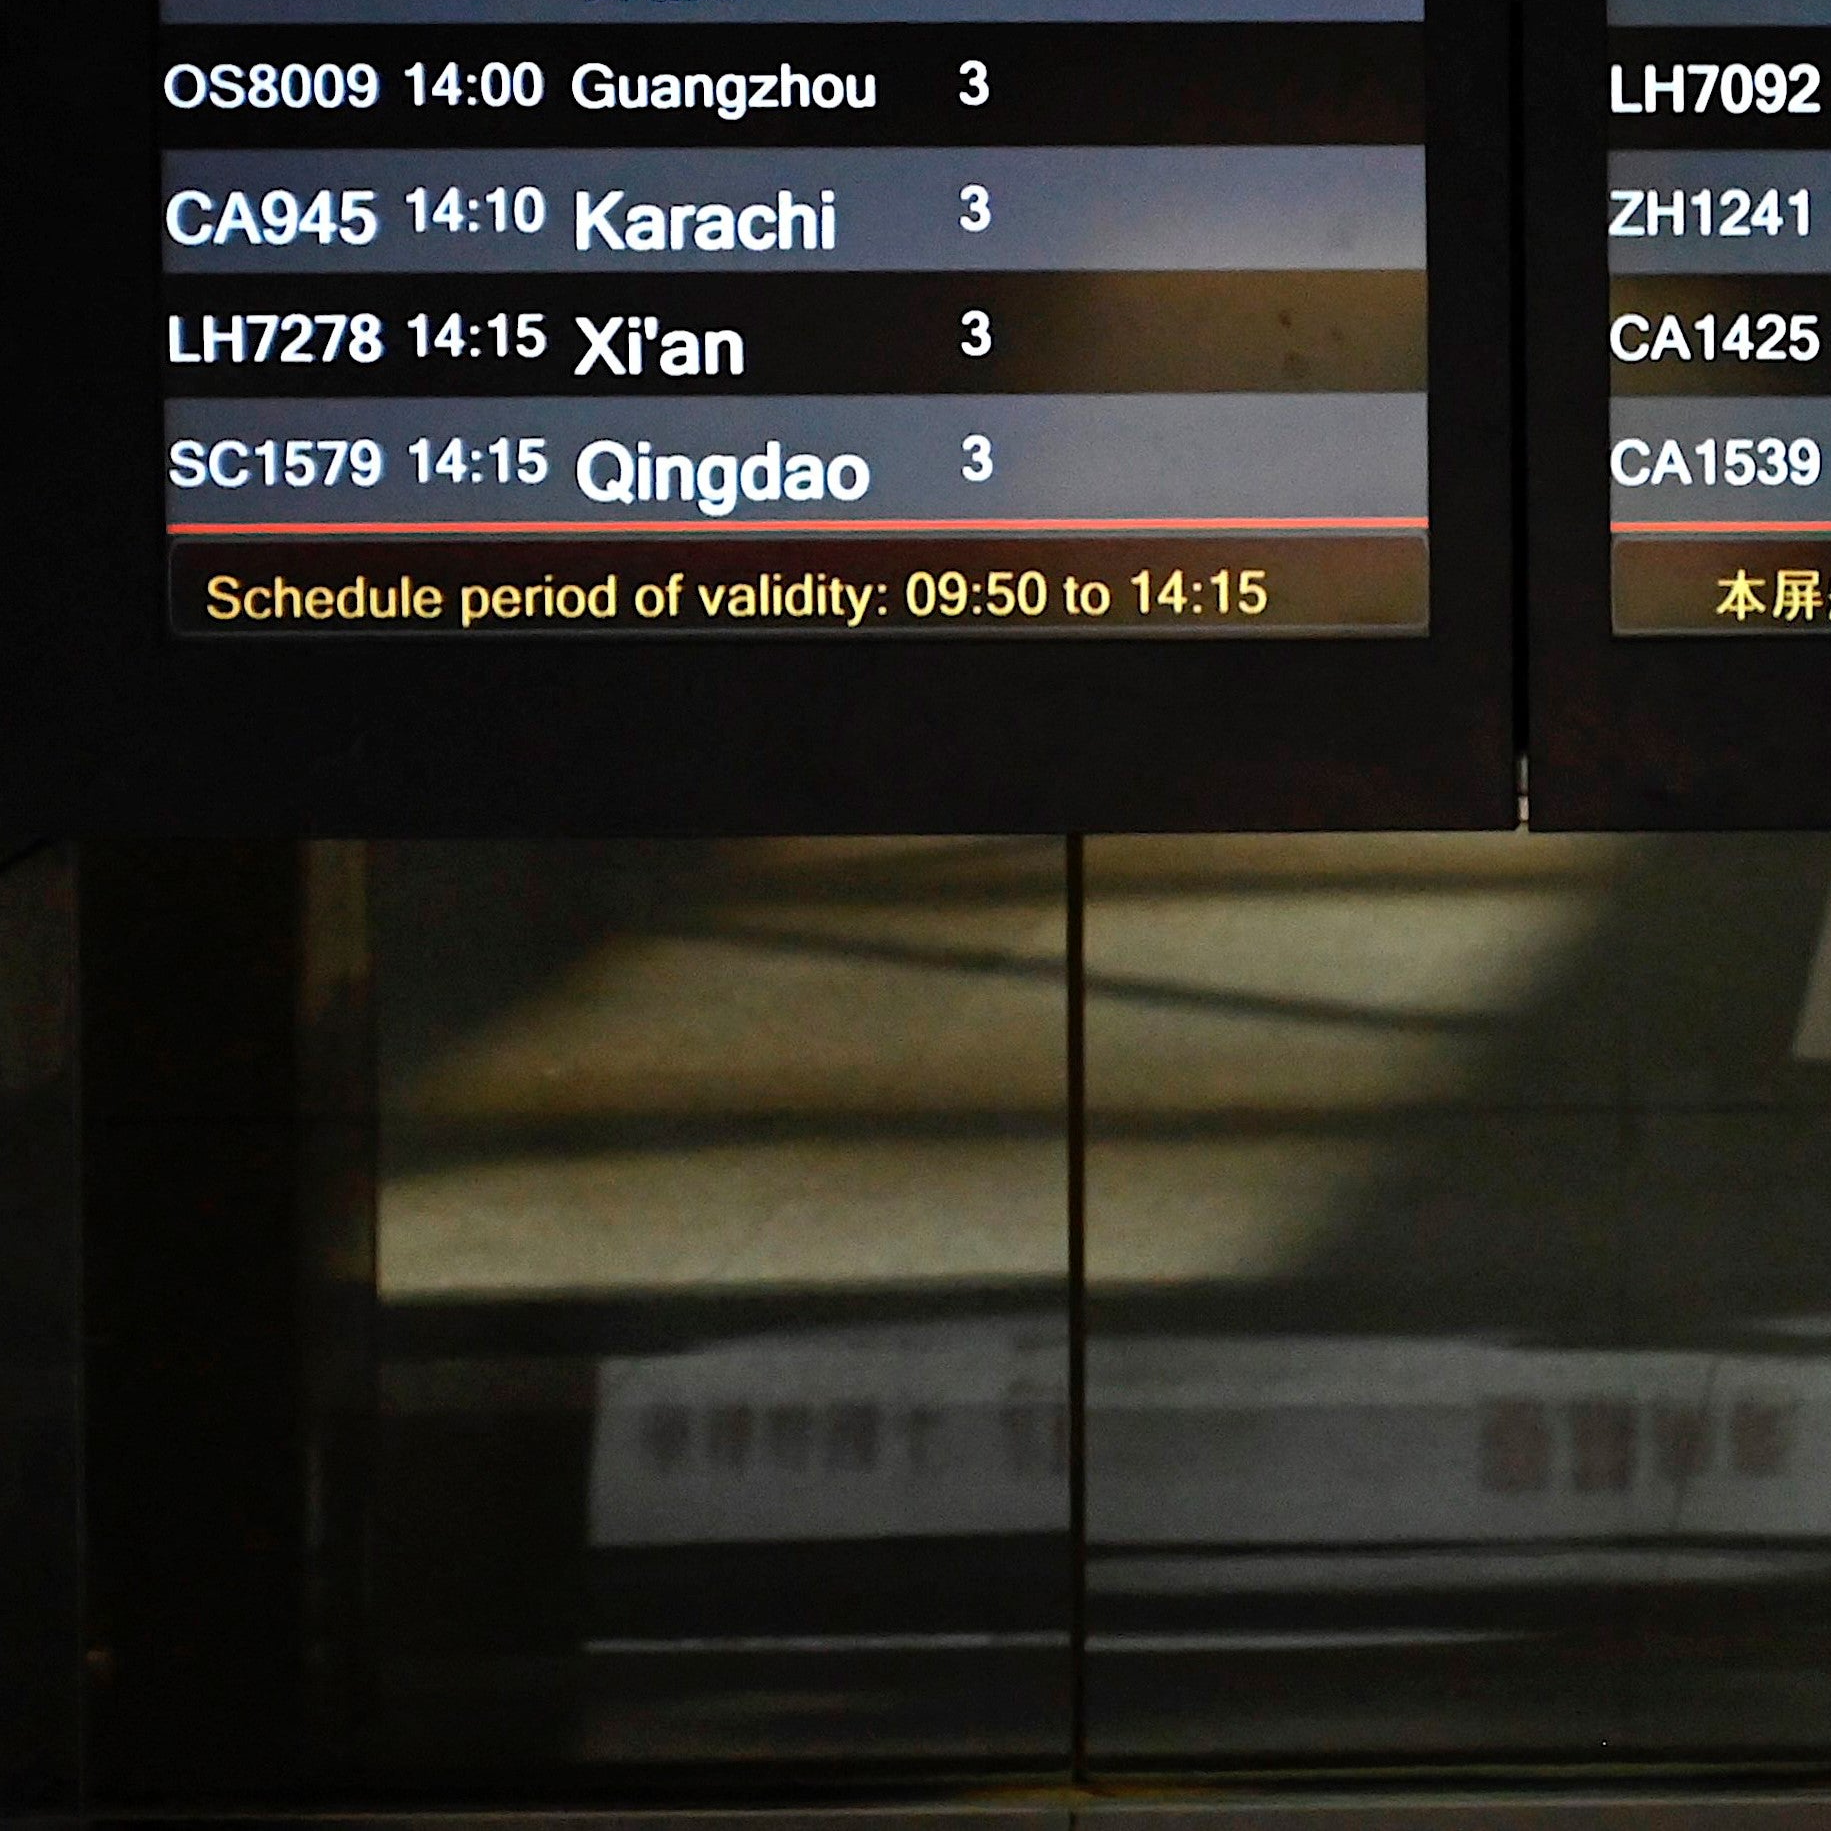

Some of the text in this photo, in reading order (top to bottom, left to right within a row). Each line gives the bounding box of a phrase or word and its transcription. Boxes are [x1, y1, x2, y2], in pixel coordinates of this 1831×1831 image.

[163, 59, 991, 122] OS8009 14:00 Guangzhou 3
[165, 183, 992, 252] CA945 14:10 Karachi 3
[168, 433, 995, 511] SC1579 14:15 Qingdao 3
[1609, 436, 1822, 488] CA1539
[206, 568, 1268, 628] Schedule period of validity: 09:50 to 14:15
